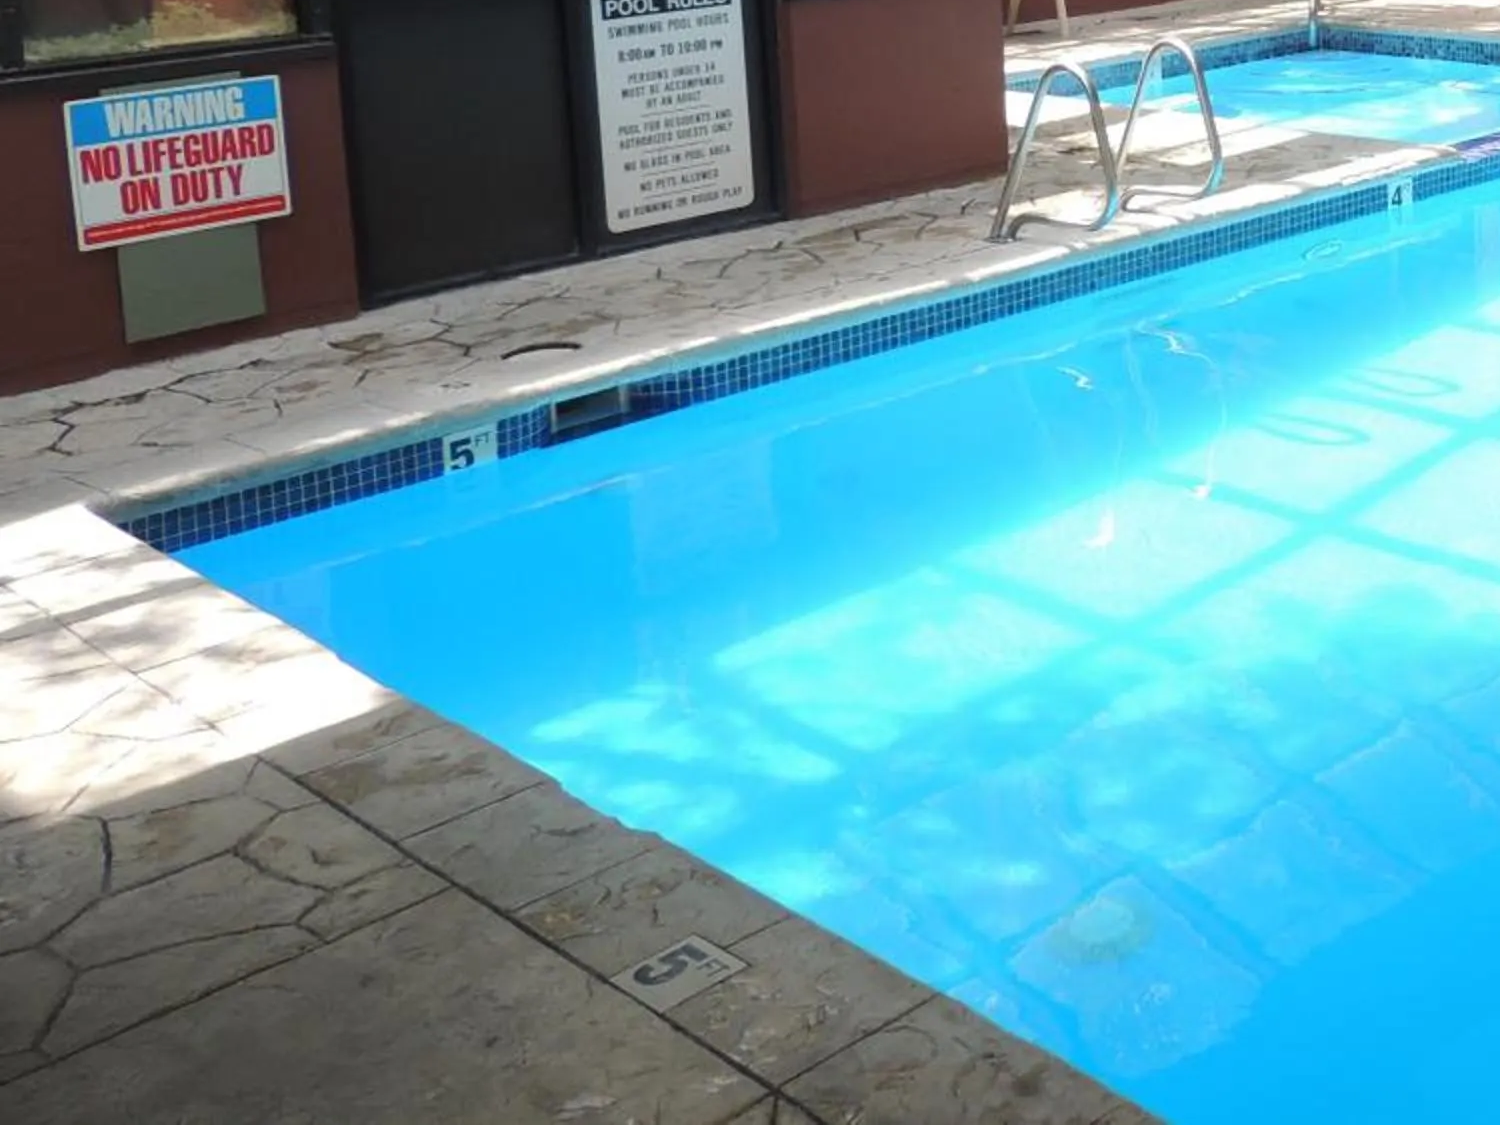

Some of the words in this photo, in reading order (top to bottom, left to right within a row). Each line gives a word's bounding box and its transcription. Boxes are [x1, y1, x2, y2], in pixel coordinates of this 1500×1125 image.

[607, 21, 664, 39] SWIMMING
[668, 17, 692, 31] POOL
[660, 43, 674, 57] TO
[678, 39, 707, 54] 10:00
[710, 39, 723, 49] PM
[628, 68, 669, 84] PERSONS
[672, 64, 701, 78] UNDER
[621, 86, 645, 99] MUST
[646, 97, 658, 108] BY
[661, 95, 673, 106] AN
[676, 90, 702, 104] ADULT
[104, 86, 245, 137] WARNING
[715, 108, 733, 120] AND
[619, 132, 673, 149] AUTHORIZED
[676, 126, 709, 140] GUESTS
[712, 121, 733, 133] ONLY
[80, 146, 122, 184] NO
[127, 123, 275, 176] LIFEGUARD
[624, 160, 636, 172] NO
[639, 155, 669, 169] GLASS
[672, 153, 681, 163] IN
[685, 150, 705, 161] POOL
[120, 177, 162, 215] ON
[171, 164, 243, 206] DUTY
[640, 180, 652, 192] NO
[655, 177, 677, 190] PETS
[681, 168, 719, 184] ALLOWED
[618, 208, 631, 219] NO
[633, 200, 673, 216] RUNNING
[675, 197, 688, 208] OR
[722, 186, 743, 198] PLAY
[1391, 184, 1403, 205] 4
[449, 436, 475, 470] 5
[632, 942, 709, 985] 5
